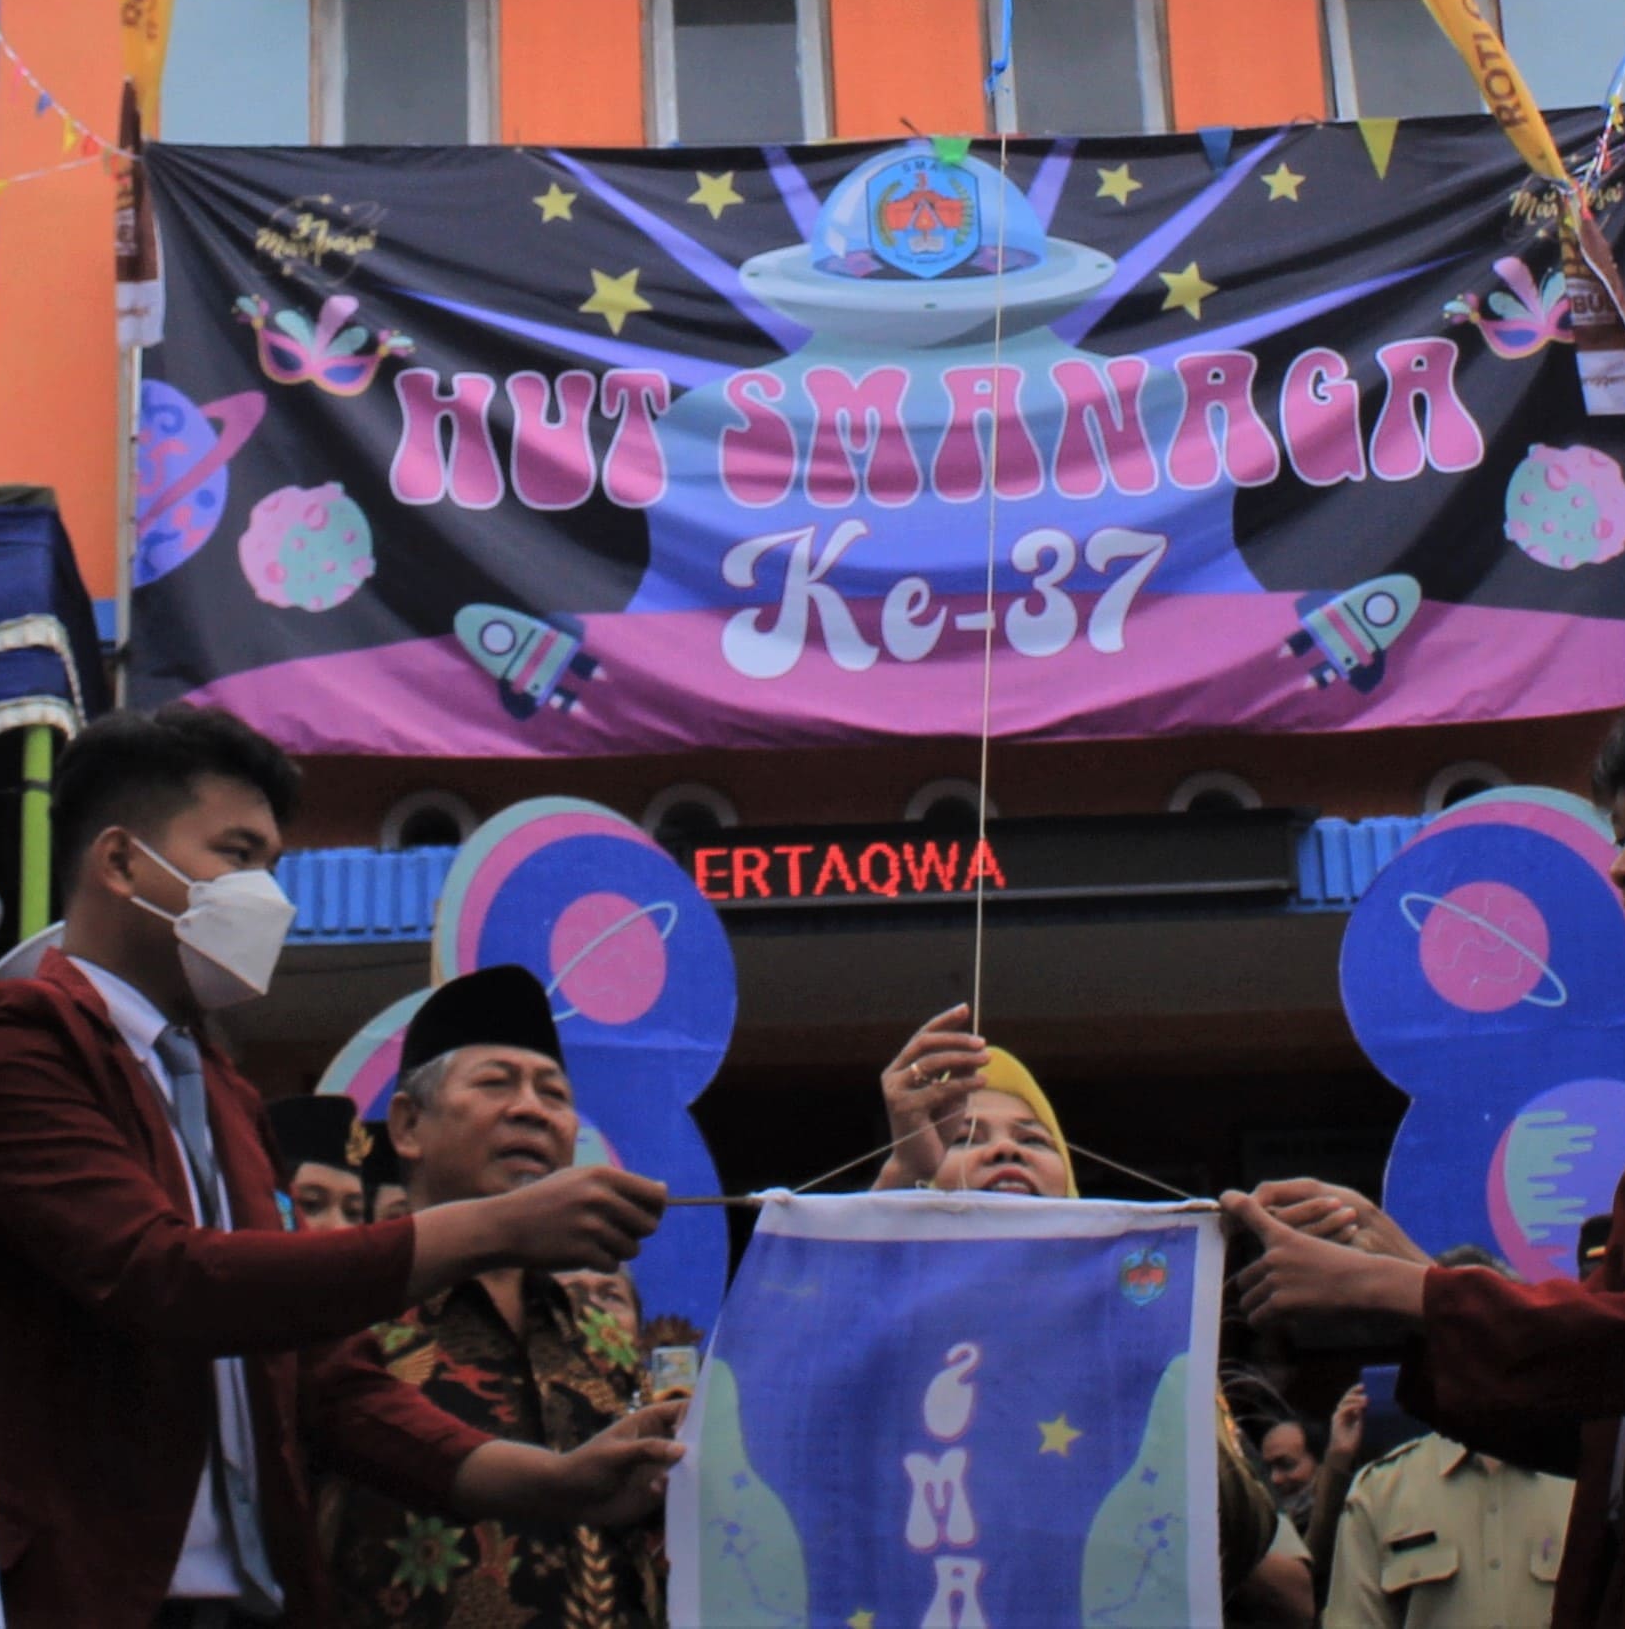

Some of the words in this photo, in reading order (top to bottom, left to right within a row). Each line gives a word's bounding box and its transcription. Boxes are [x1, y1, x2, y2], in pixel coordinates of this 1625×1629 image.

[1472, 30, 1529, 131] ROTI
[389, 367, 671, 511] HUT
[719, 336, 1485, 509] SMANAGA
[720, 518, 1168, 681] Ke-37
